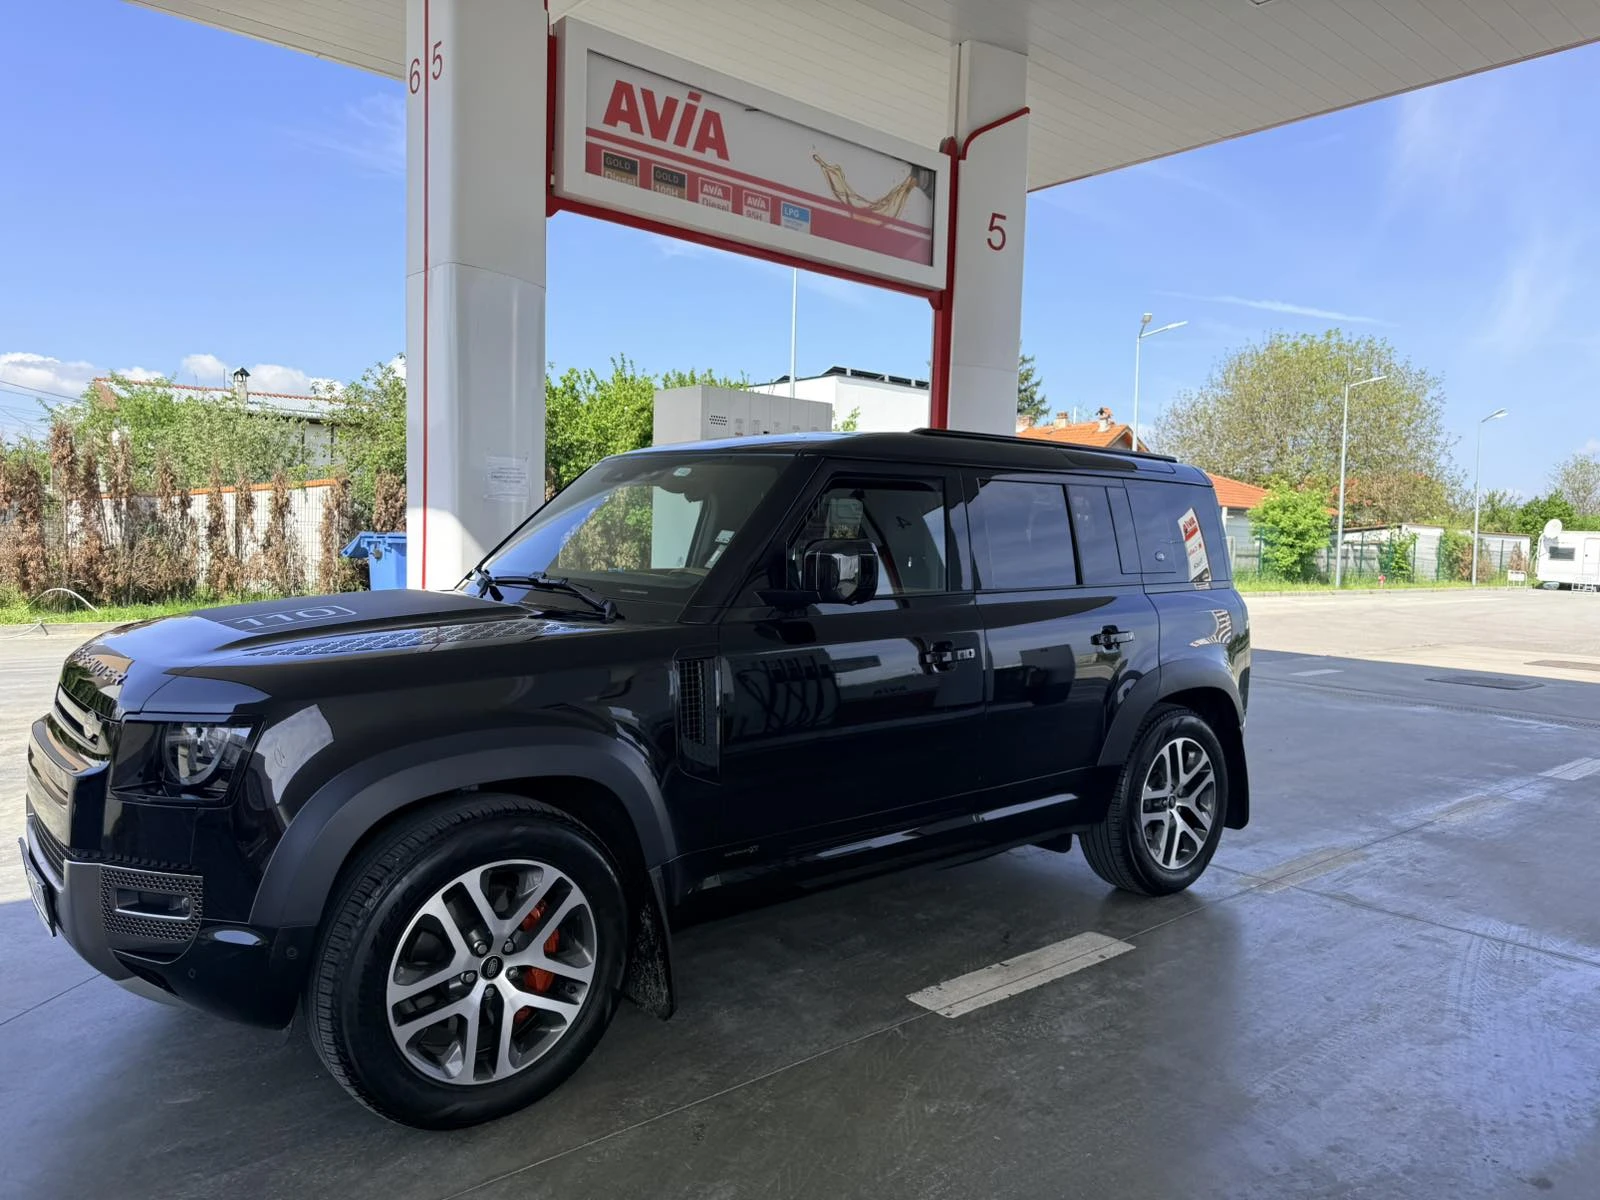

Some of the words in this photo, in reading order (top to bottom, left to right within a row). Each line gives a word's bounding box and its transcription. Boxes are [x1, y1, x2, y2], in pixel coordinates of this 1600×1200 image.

[432, 40, 443, 80] 5
[410, 58, 420, 94] 6
[605, 156, 631, 170] GOLD
[655, 170, 679, 184] GOLD
[784, 206, 799, 218] LPG
[987, 212, 1006, 251] 5
[235, 608, 337, 626] 110
